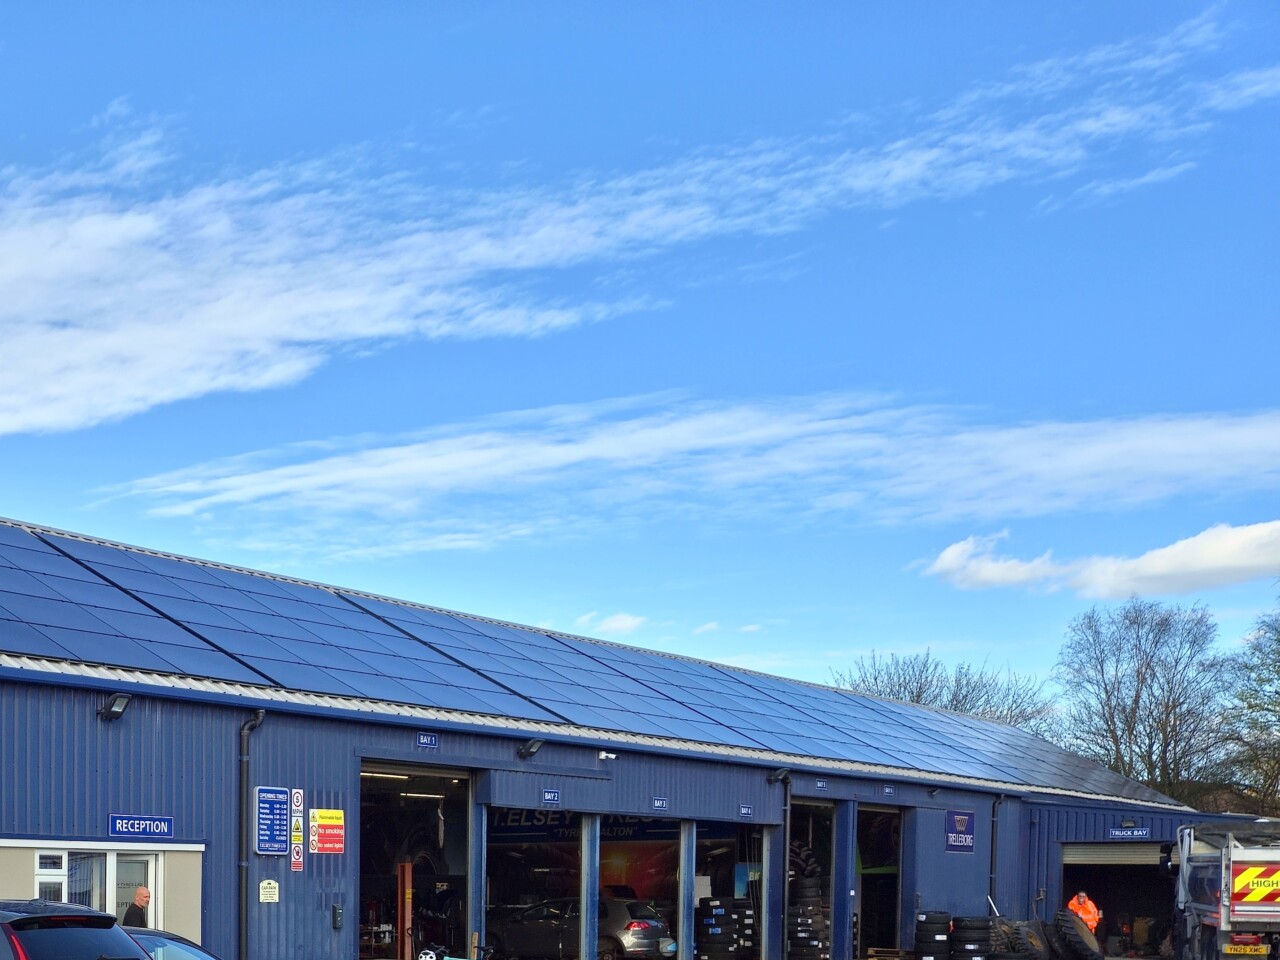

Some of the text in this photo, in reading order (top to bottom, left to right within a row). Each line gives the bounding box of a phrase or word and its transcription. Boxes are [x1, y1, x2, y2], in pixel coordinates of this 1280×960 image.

[420, 734, 431, 744] BAY
[295, 795, 300, 804] 5
[544, 792, 553, 800] BAY
[654, 799, 663, 807] BAY
[116, 819, 168, 833] RECEPTION
[325, 827, 344, 836] smoking
[601, 825, 638, 837] ALTON"
[947, 833, 974, 846] TRELLEBORG
